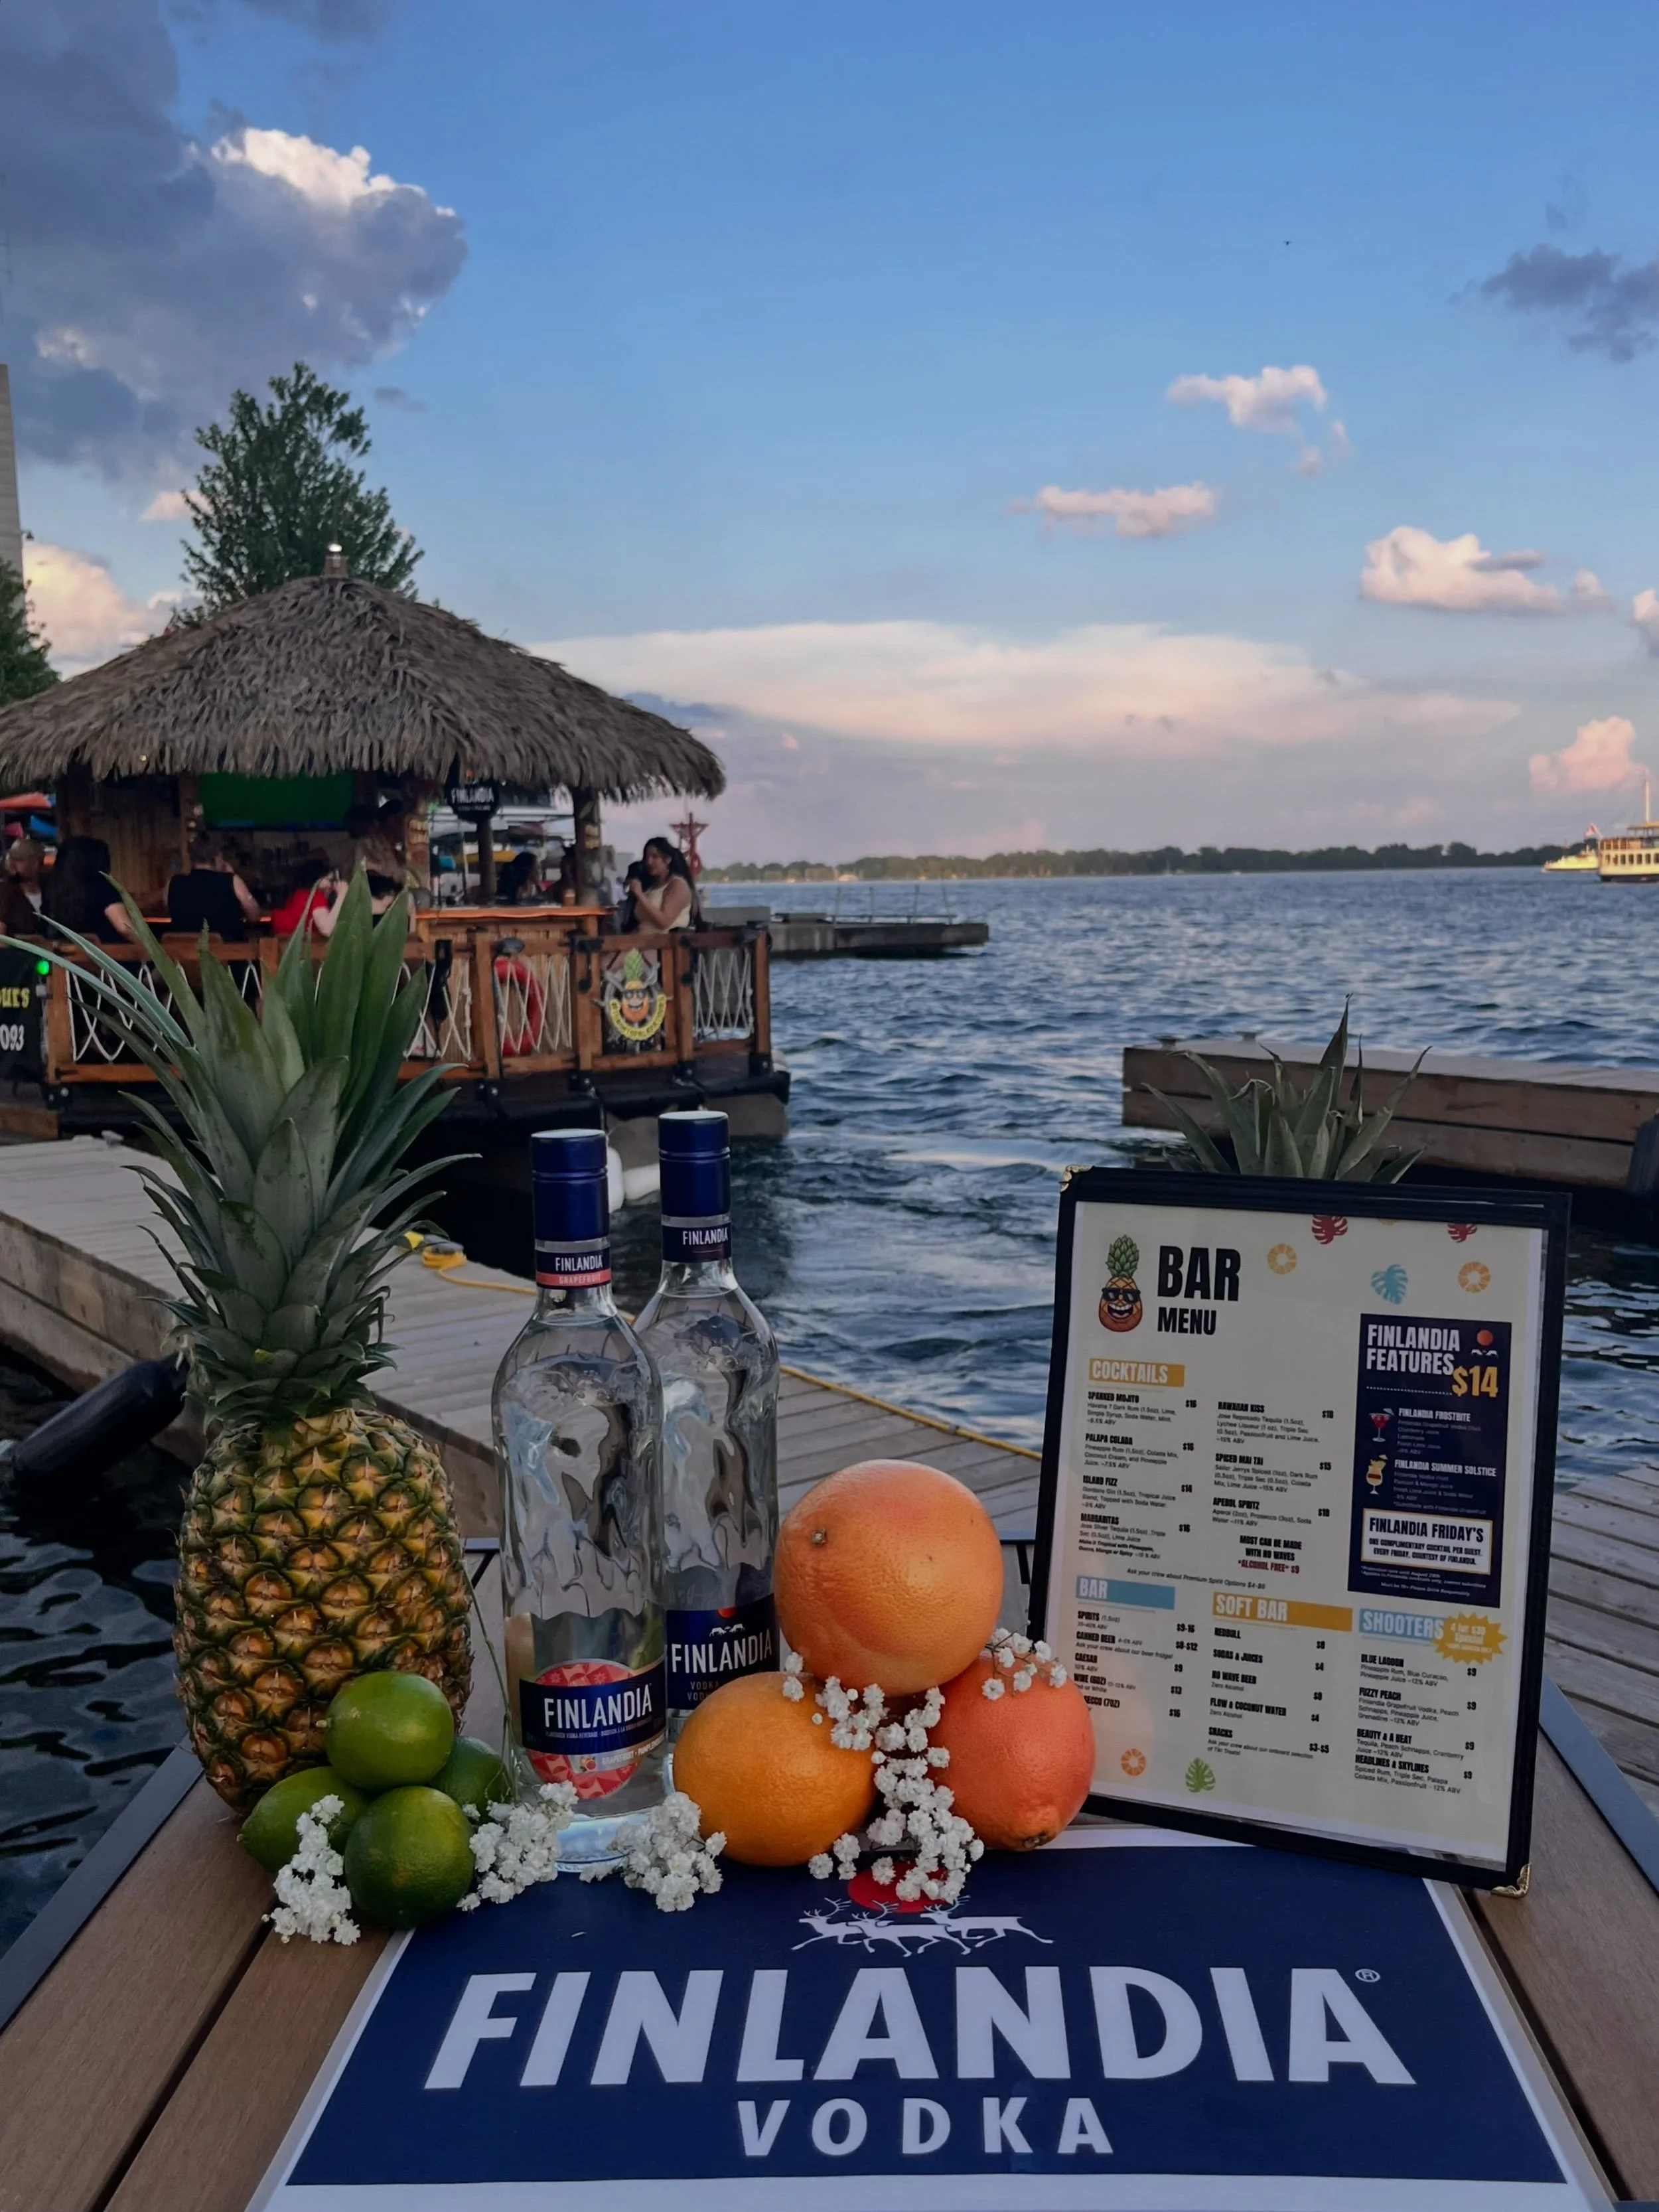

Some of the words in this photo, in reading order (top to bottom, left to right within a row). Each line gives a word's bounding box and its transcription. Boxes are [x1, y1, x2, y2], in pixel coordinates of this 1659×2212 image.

[451, 787, 494, 803] FINLANDIA
[682, 1226, 729, 1246] FINLANDIA
[555, 1254, 603, 1272] FINLANDIA
[1158, 1245, 1241, 1301] BAR
[1157, 1306, 1217, 1336] MENU
[1366, 1324, 1460, 1352] FINLANDIA
[1366, 1348, 1455, 1376] FEATURES
[1092, 1360, 1169, 1384] COCKTAILS
[1451, 1365, 1498, 1398] $14
[1399, 1408, 1433, 1418] FINLANDIA
[1435, 1411, 1471, 1422] FROSTBITE
[1086, 1434, 1108, 1442] PALAPA
[1396, 1459, 1430, 1470] FINLANDIA
[1431, 1463, 1462, 1473] SUMMER
[1465, 1465, 1496, 1476] SOLSTICE
[1084, 1475, 1104, 1485] ISLAND
[1214, 1498, 1236, 1507] APEROL
[1238, 1500, 1259, 1509] SPRITZ
[1082, 1513, 1119, 1524] MARGARITAS
[1370, 1517, 1427, 1536] FINLANDIA
[1432, 1523, 1483, 1542] FRIDAY'S
[1240, 1535, 1258, 1544] MOST
[1260, 1537, 1271, 1546] CAN
[1274, 1538, 1281, 1547] BE
[1283, 1540, 1301, 1549] MADE
[1246, 1548, 1261, 1557] WITH
[1274, 1551, 1295, 1560] WAVES
[1080, 1578, 1108, 1599] BAR
[1216, 1594, 1252, 1617] SOFT
[1258, 1599, 1287, 1621] BAR
[1078, 1611, 1099, 1620] SPIRITS
[1362, 1610, 1444, 1639] SHOOTERS
[1076, 1631, 1098, 1641] CANNED
[1101, 1635, 1115, 1643] BEER
[670, 1627, 772, 1674] FINLANDIA
[1075, 1653, 1097, 1662] CAESAR
[1242, 1653, 1262, 1662] JUICES
[1362, 1654, 1376, 1663] BLUE
[1379, 1656, 1404, 1666] LAGOON
[1074, 1673, 1088, 1682] WINE
[1222, 1672, 1239, 1682] WAVE
[1242, 1674, 1256, 1684] BEER
[1467, 1667, 1476, 1676] $9
[1360, 1687, 1378, 1698] FUZZY
[1380, 1690, 1401, 1700] PEACH
[543, 1684, 653, 1730] FINLANDIA
[1211, 1698, 1227, 1708] FLOW
[1236, 1701, 1263, 1712] COCONUT
[1265, 1705, 1286, 1716] WATER
[1467, 1701, 1476, 1710] $9
[1209, 1727, 1232, 1737] SNACKS
[1358, 1729, 1380, 1739] BEAUTY
[1390, 1733, 1394, 1741] A
[1396, 1734, 1411, 1743] BEAT
[1465, 1741, 1474, 1750] $9
[1356, 1755, 1390, 1767] HEADLINES
[1399, 1761, 1429, 1773] SKYLINES
[424, 1966, 1418, 2089] FINLANDIA
[738, 2097, 1115, 2157] VODKA
